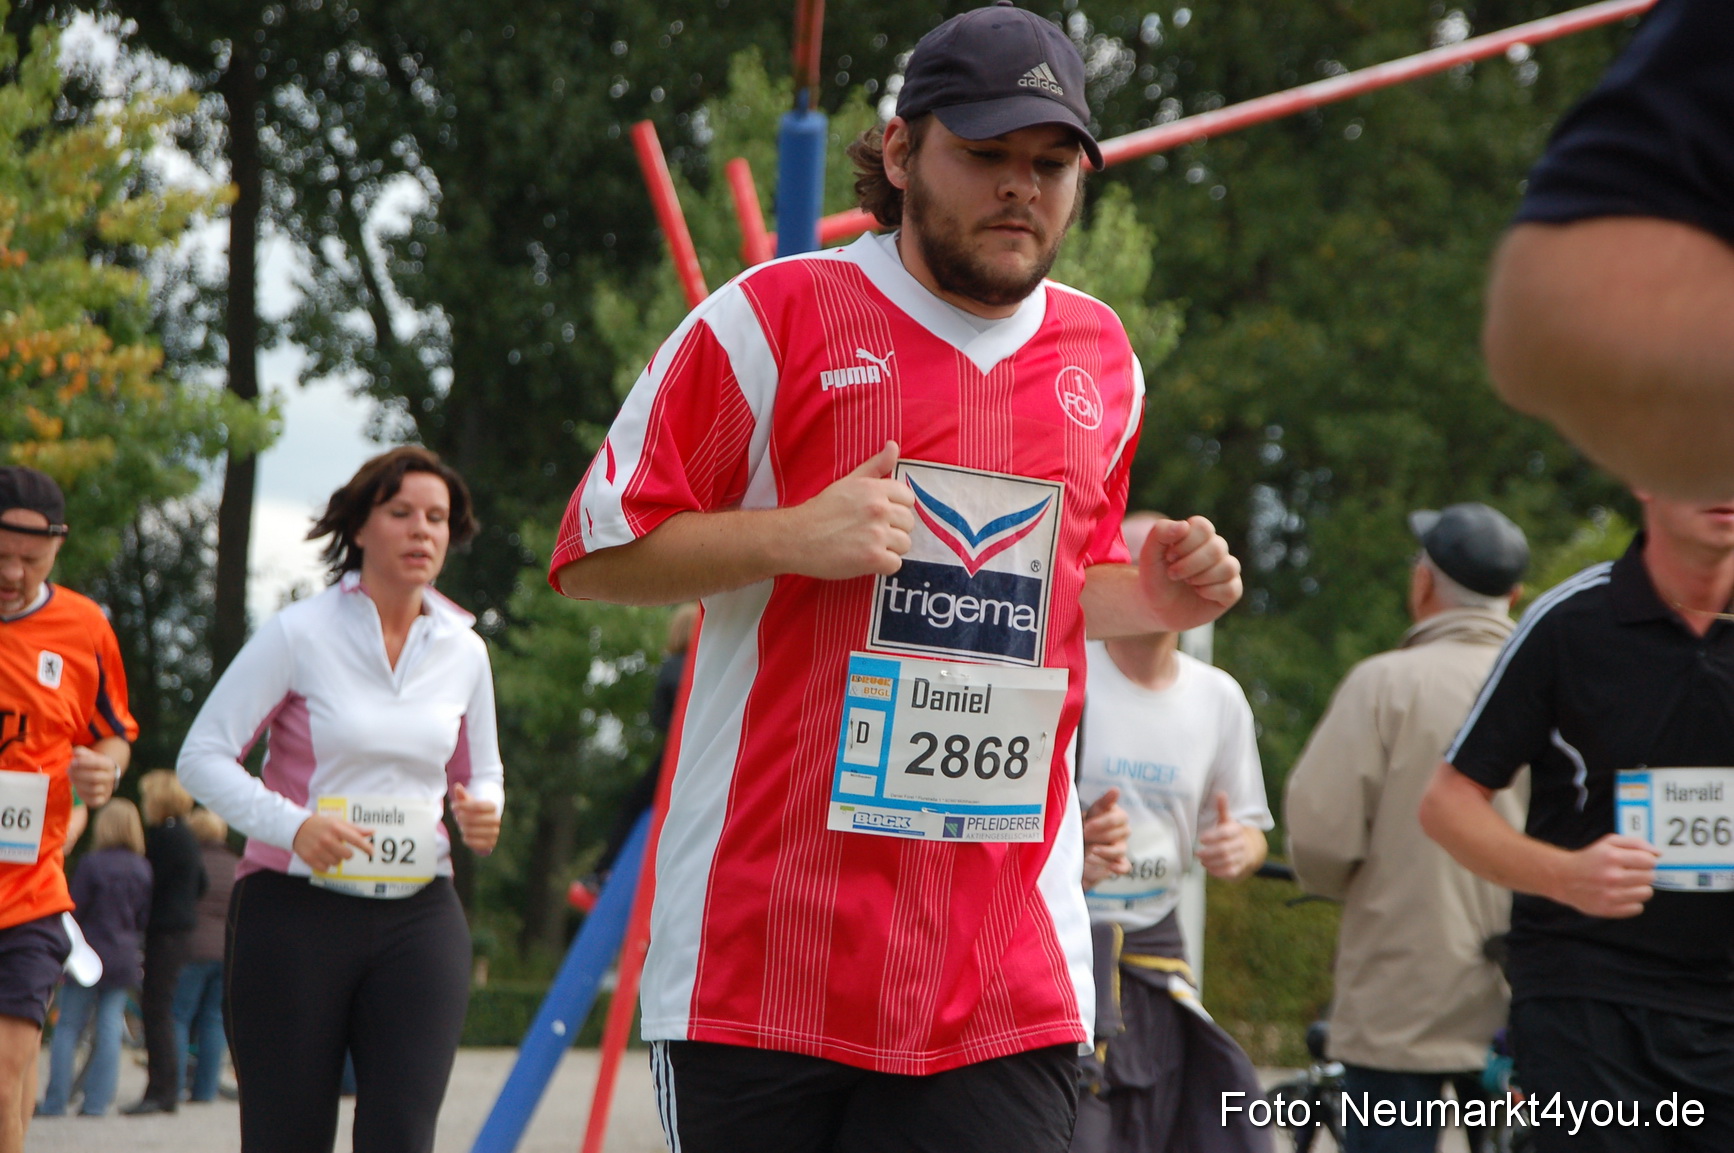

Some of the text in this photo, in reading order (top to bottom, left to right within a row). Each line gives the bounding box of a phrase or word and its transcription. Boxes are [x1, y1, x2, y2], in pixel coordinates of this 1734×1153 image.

[1017, 78, 1064, 96] adidas
[820, 365, 881, 391] PUMA
[1063, 391, 1099, 422] FCN
[884, 577, 1038, 633] trigema
[911, 677, 992, 714] Daniel
[856, 721, 870, 744] D
[904, 731, 1030, 780] 2868
[1104, 756, 1179, 784] UNICEF
[1665, 781, 1723, 802] Harald
[352, 804, 405, 825] Daniela
[853, 812, 912, 828] BOCK
[966, 816, 1040, 831] PFLEIDERER
[965, 832, 1040, 841] AKTIENGESELLSCHAFT
[1668, 816, 1733, 846] 266
